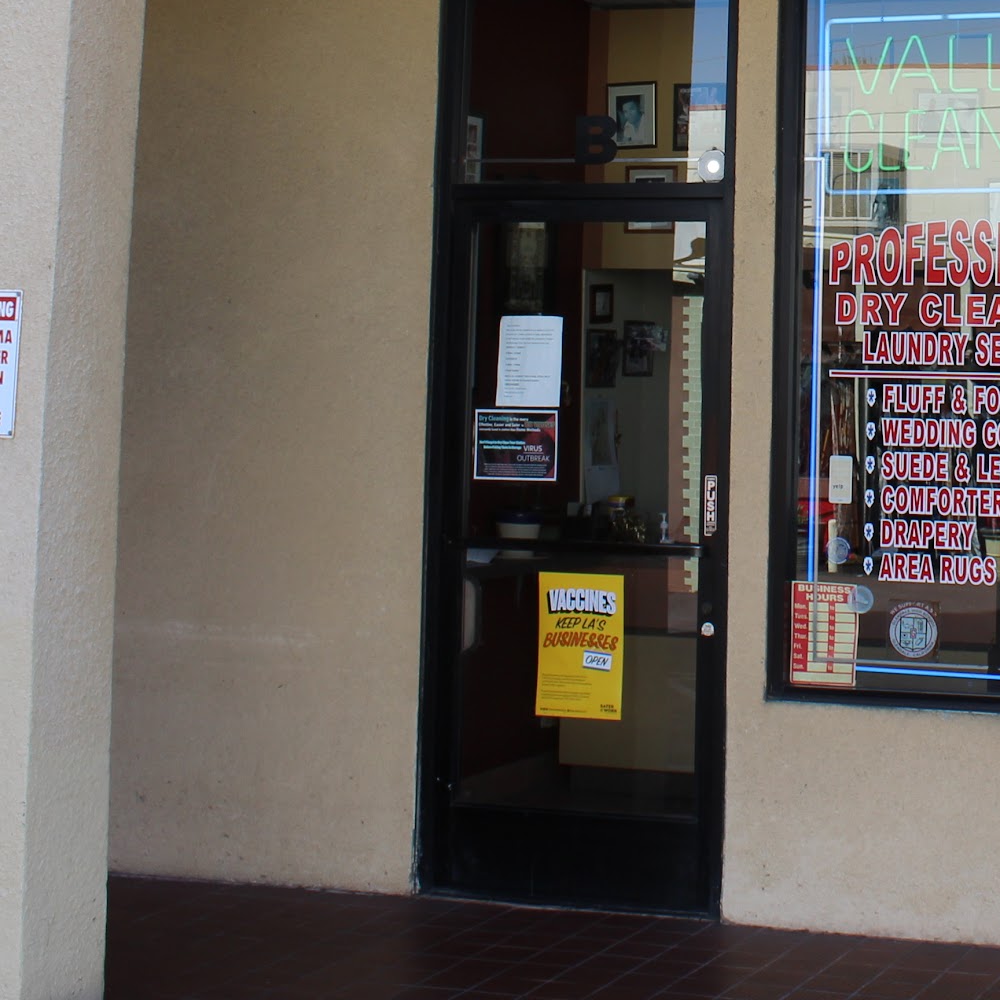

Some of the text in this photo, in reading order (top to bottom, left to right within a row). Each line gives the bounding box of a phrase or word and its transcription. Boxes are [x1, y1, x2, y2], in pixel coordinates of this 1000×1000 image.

[575, 115, 618, 165] B
[835, 293, 908, 327] DRY
[862, 331, 971, 366] LAUNDRY
[881, 384, 945, 414] FLUFF
[951, 386, 968, 415] &
[881, 418, 977, 449] WEDDING
[516, 454, 551, 462] OUTBREAK
[881, 453, 948, 481] SUEDE
[954, 454, 971, 482] &
[706, 480, 716, 522] PUSH
[880, 519, 976, 551] DRAPERY
[878, 553, 998, 587] AREA RUGS
[547, 588, 617, 616] VACCINES
[555, 617, 607, 631] KEEP LA'S
[543, 631, 619, 651] BUSINESSES
[585, 655, 609, 667] OPEN
